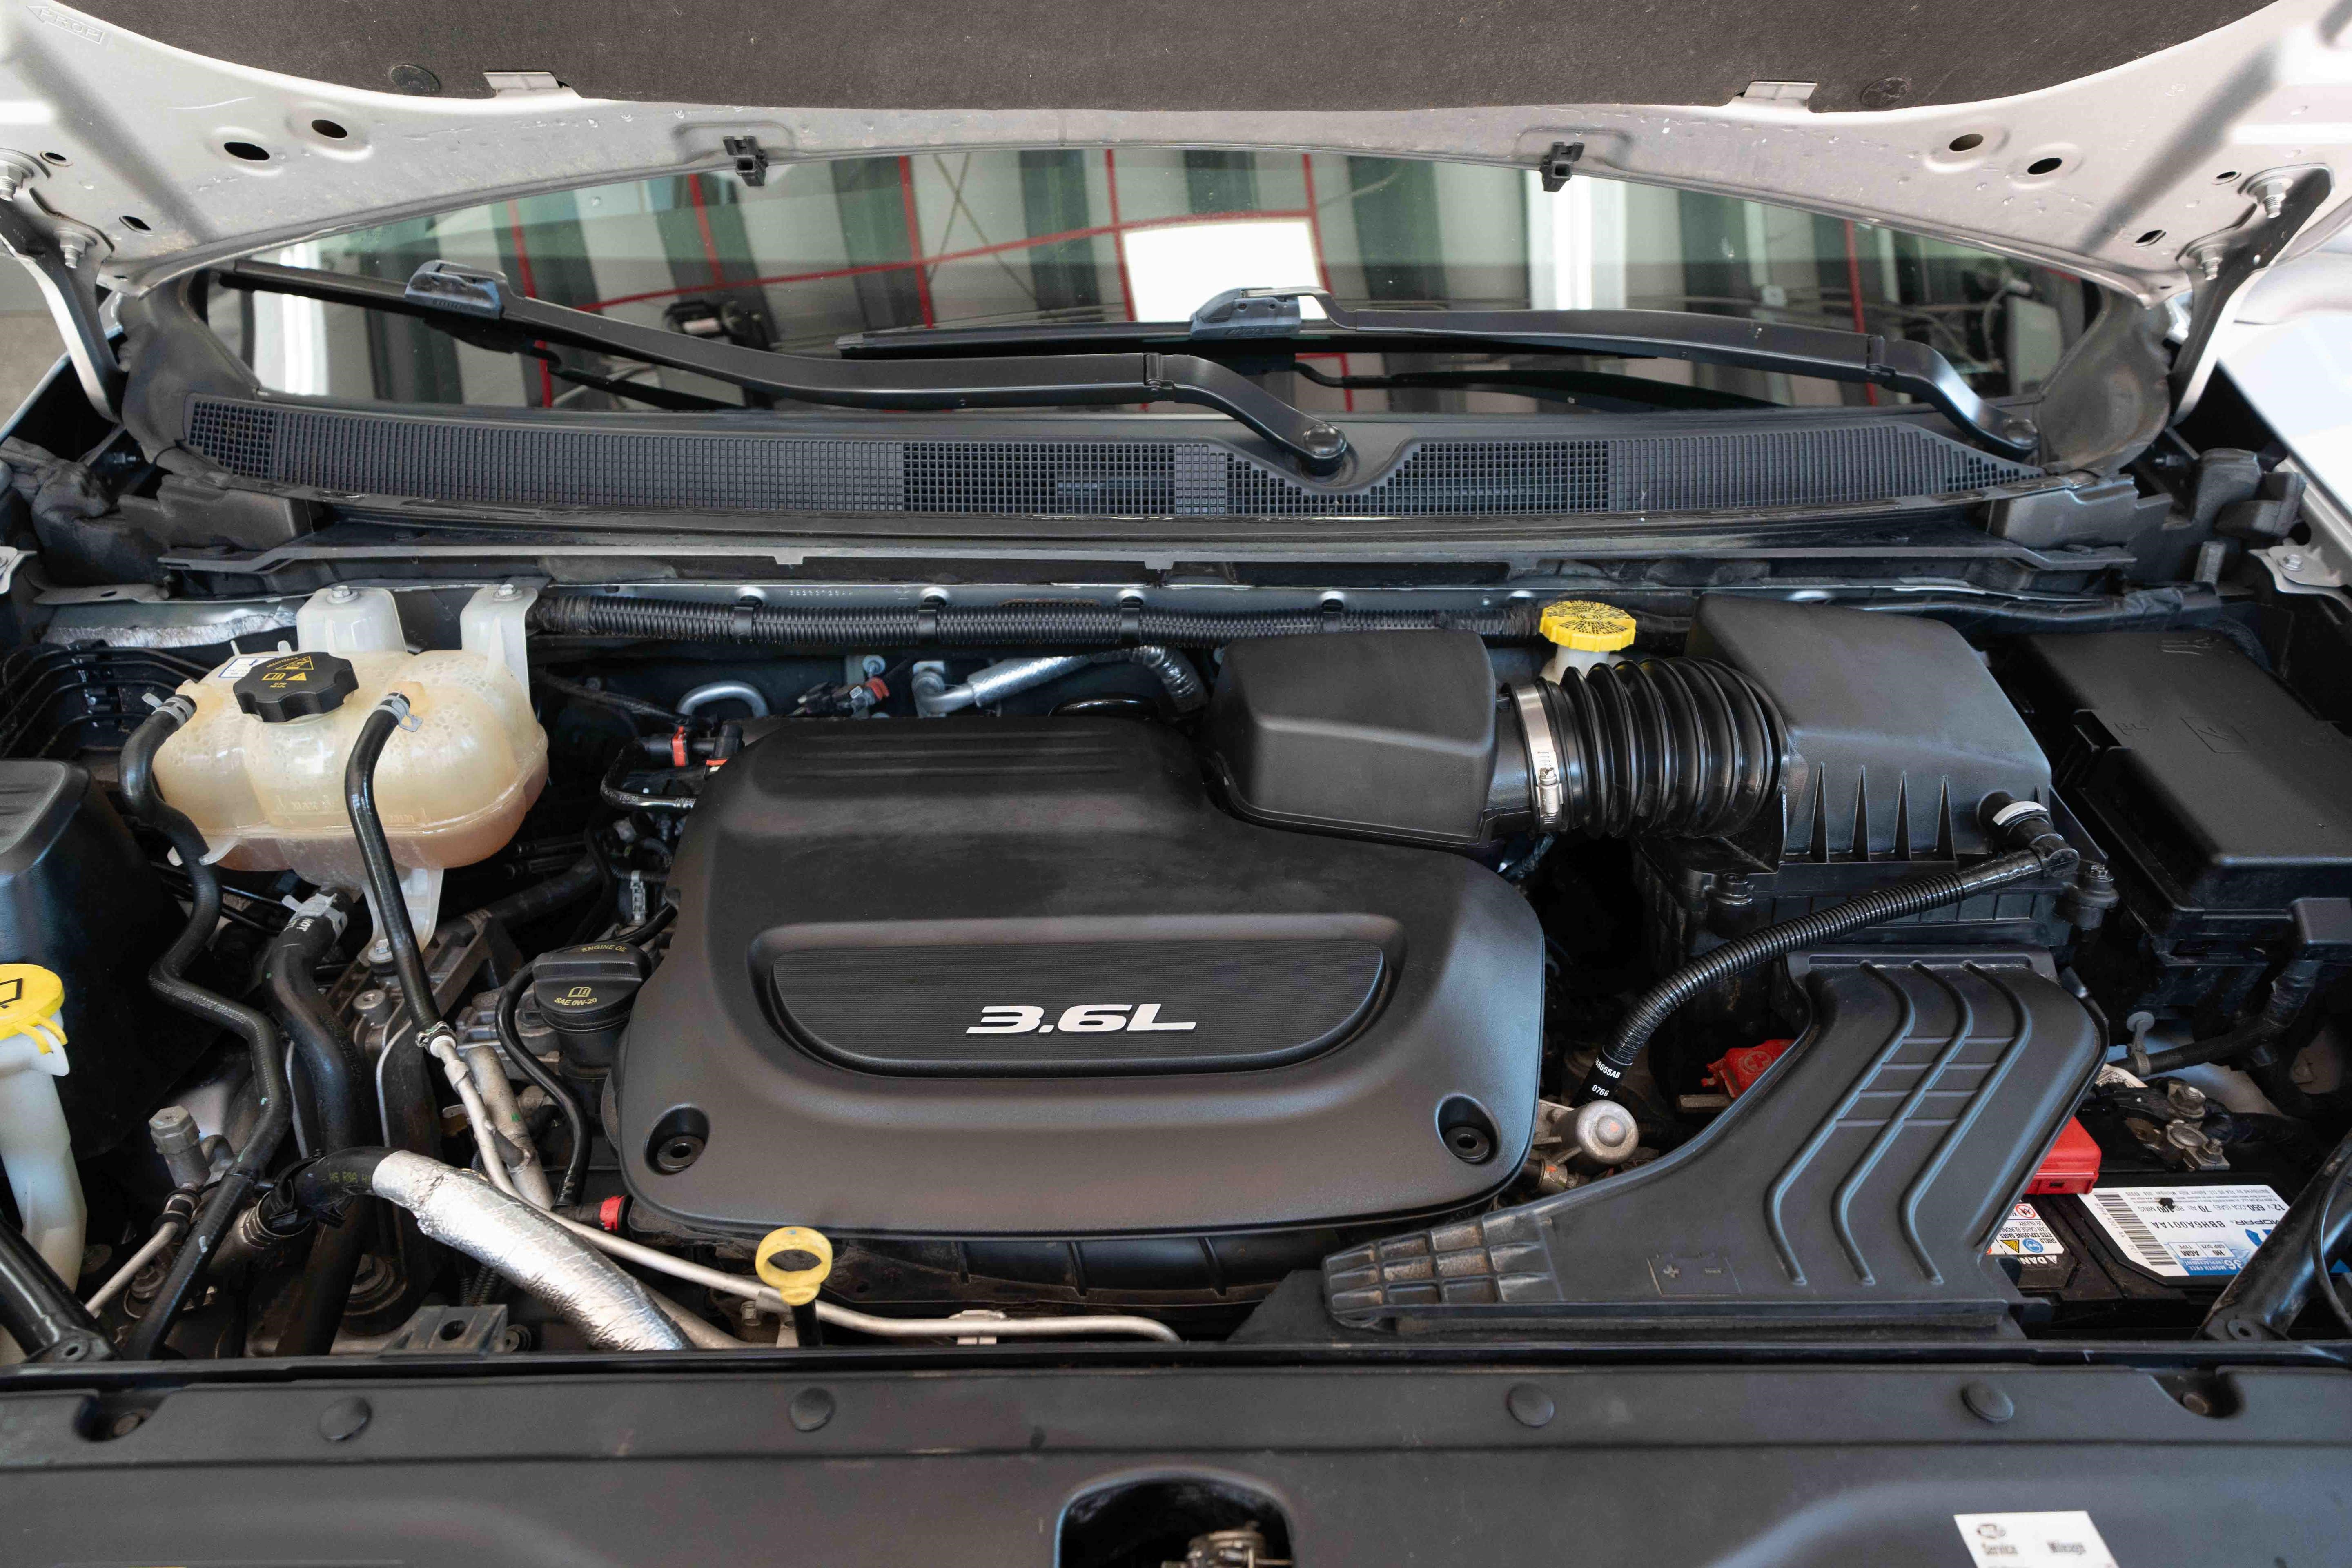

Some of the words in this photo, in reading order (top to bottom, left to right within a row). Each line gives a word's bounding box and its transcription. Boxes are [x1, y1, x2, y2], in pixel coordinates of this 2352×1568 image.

[39, 9, 98, 38] PROP
[581, 944, 615, 952] ENGINE
[554, 997, 571, 1006] SAE
[571, 998, 597, 1006] 0W-20
[966, 1003, 1196, 1036] 3.6L
[1592, 1084, 1609, 1097] 0766
[2150, 1220, 2226, 1228] BBH6A001AA
[2223, 1259, 2243, 1270] 36
